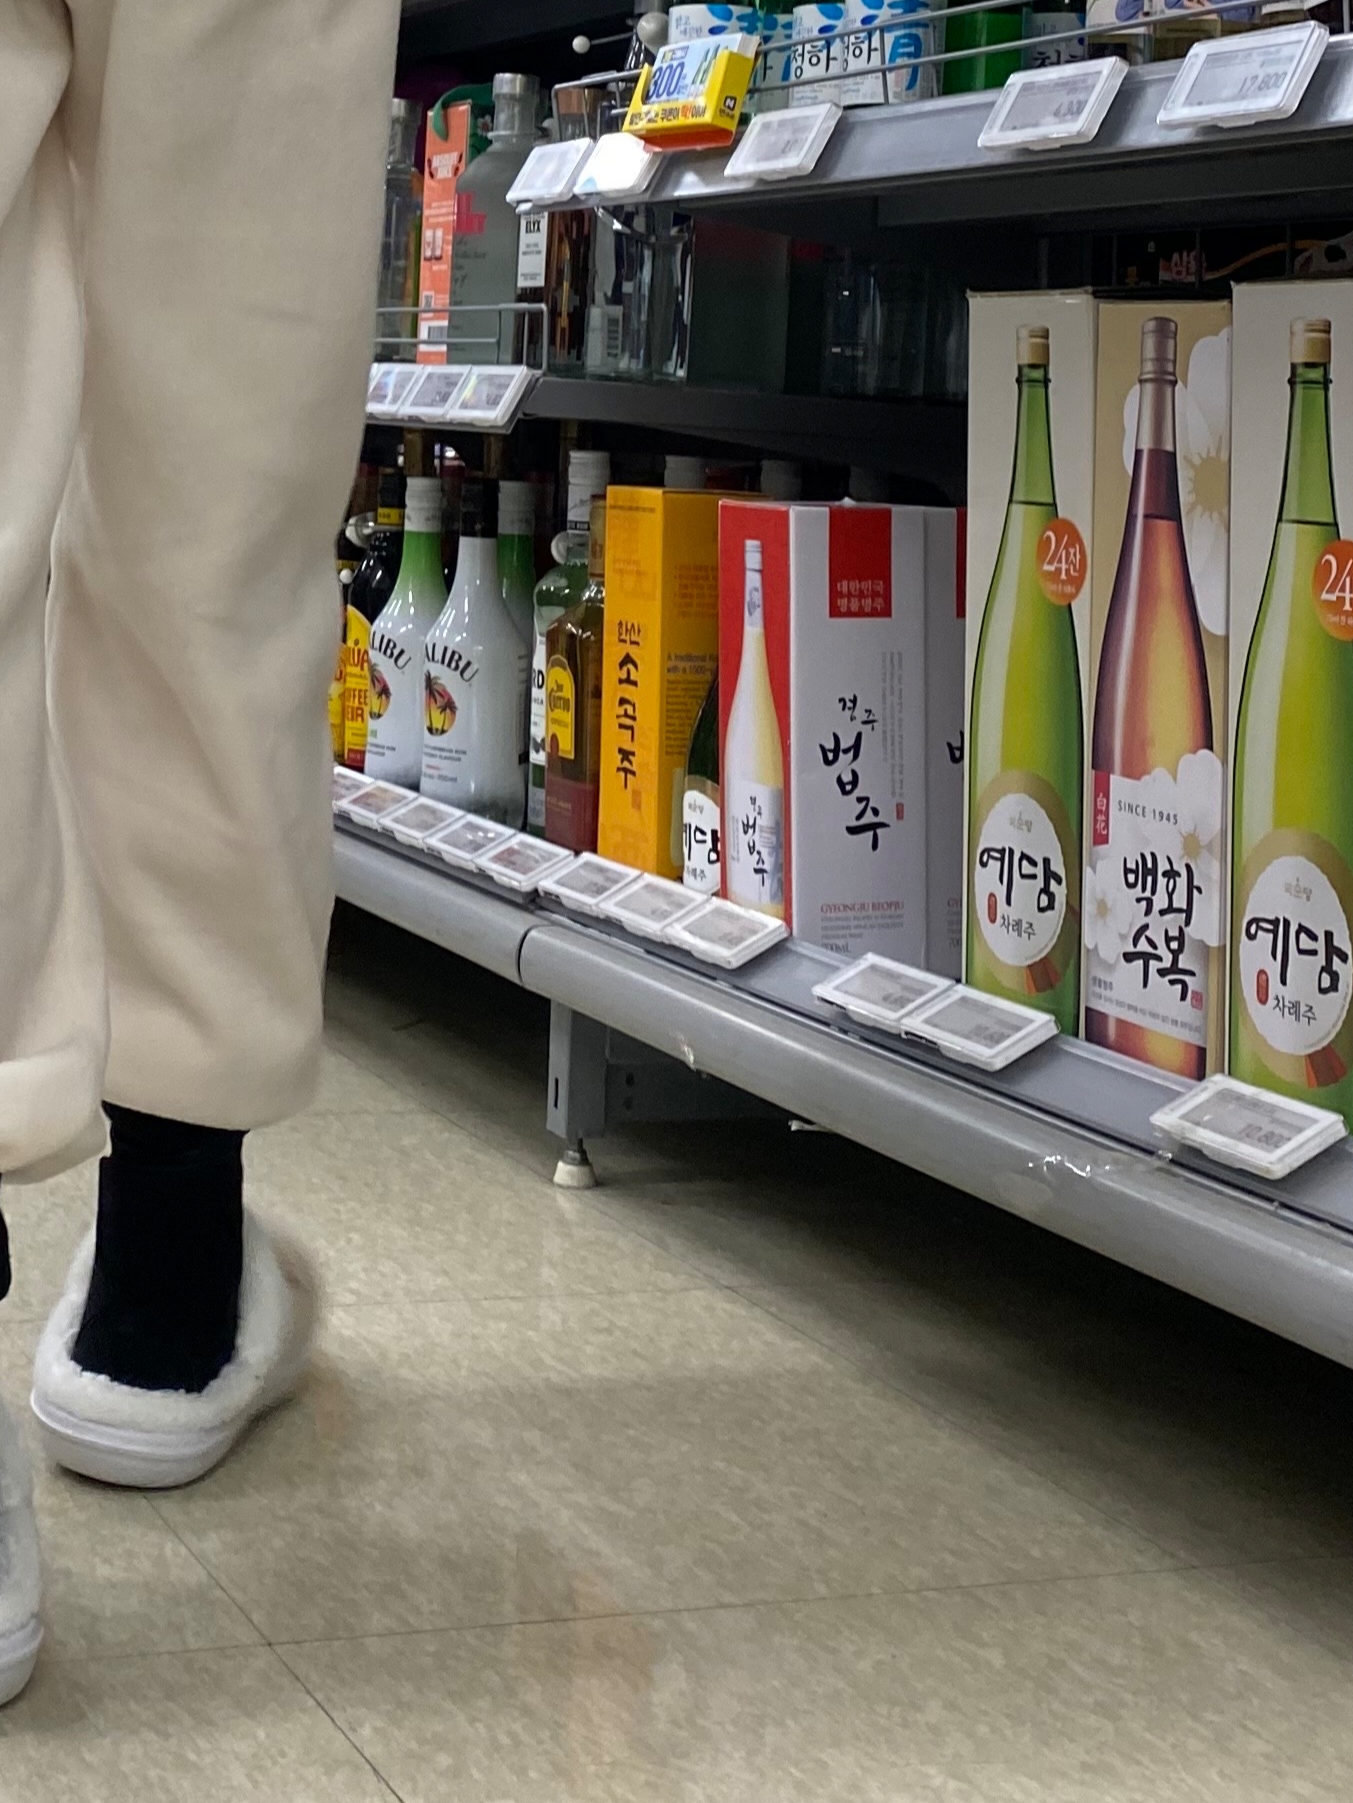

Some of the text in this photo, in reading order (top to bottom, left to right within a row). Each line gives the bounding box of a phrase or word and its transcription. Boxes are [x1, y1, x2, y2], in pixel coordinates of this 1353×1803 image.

[1042, 530, 1081, 581] 24잔
[617, 620, 642, 647] 한산
[615, 651, 640, 790] 소곡주
[838, 693, 879, 732] 경주
[817, 728, 892, 853] 법주
[1096, 794, 1108, 836] 白花
[1117, 799, 1180, 826] SINCE 1945
[741, 813, 769, 887] 법주
[979, 846, 1063, 914] 예담
[1123, 851, 1203, 928] 백화
[1000, 913, 1037, 941] 차례주
[1245, 915, 1349, 995] 예담
[1122, 923, 1197, 1003] 수복
[1273, 993, 1318, 1027] 차례주
